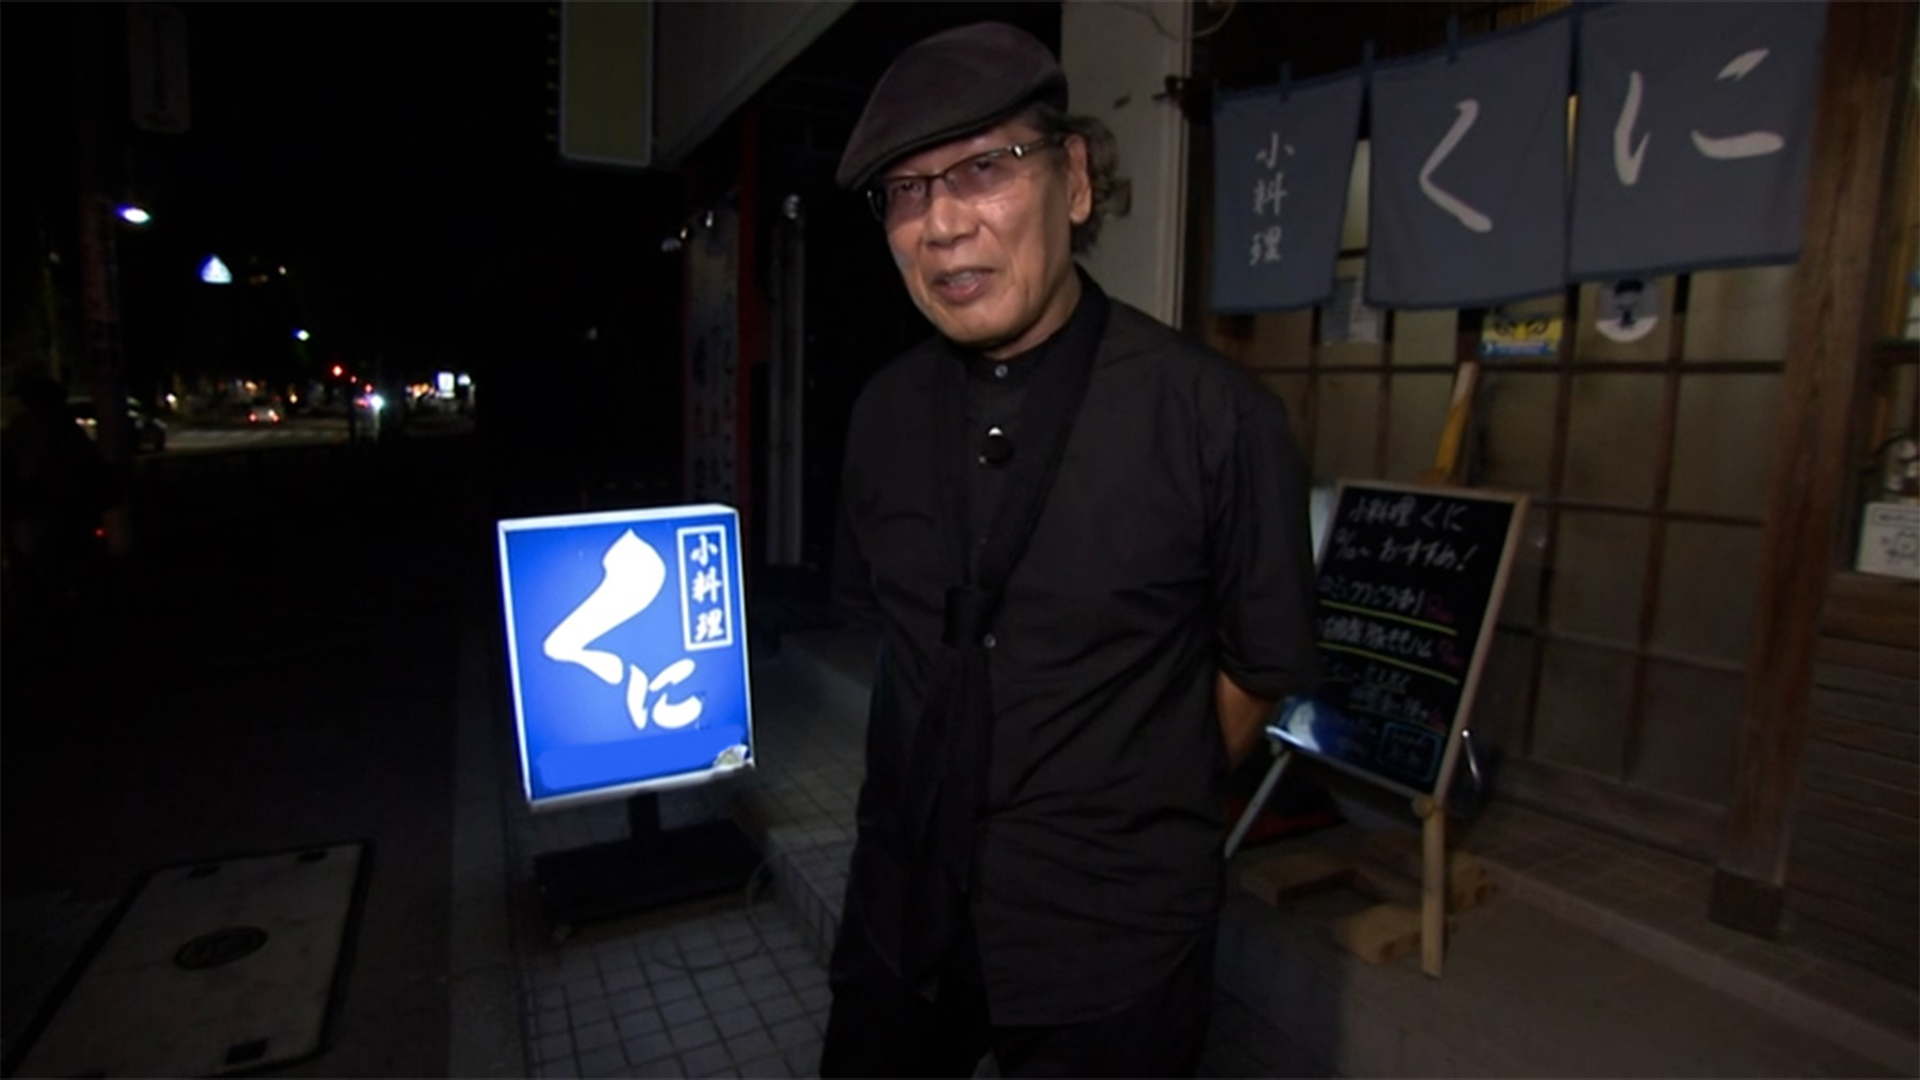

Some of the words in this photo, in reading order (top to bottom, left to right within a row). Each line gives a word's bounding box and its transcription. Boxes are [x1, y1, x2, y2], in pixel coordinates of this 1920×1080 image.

[1250, 132, 1296, 266] 小料理
[1418, 47, 1786, 234] くに
[1348, 495, 1417, 527] 小料理
[1420, 500, 1469, 533] くに
[543, 528, 703, 730] くに
[690, 533, 724, 642] 小料理
